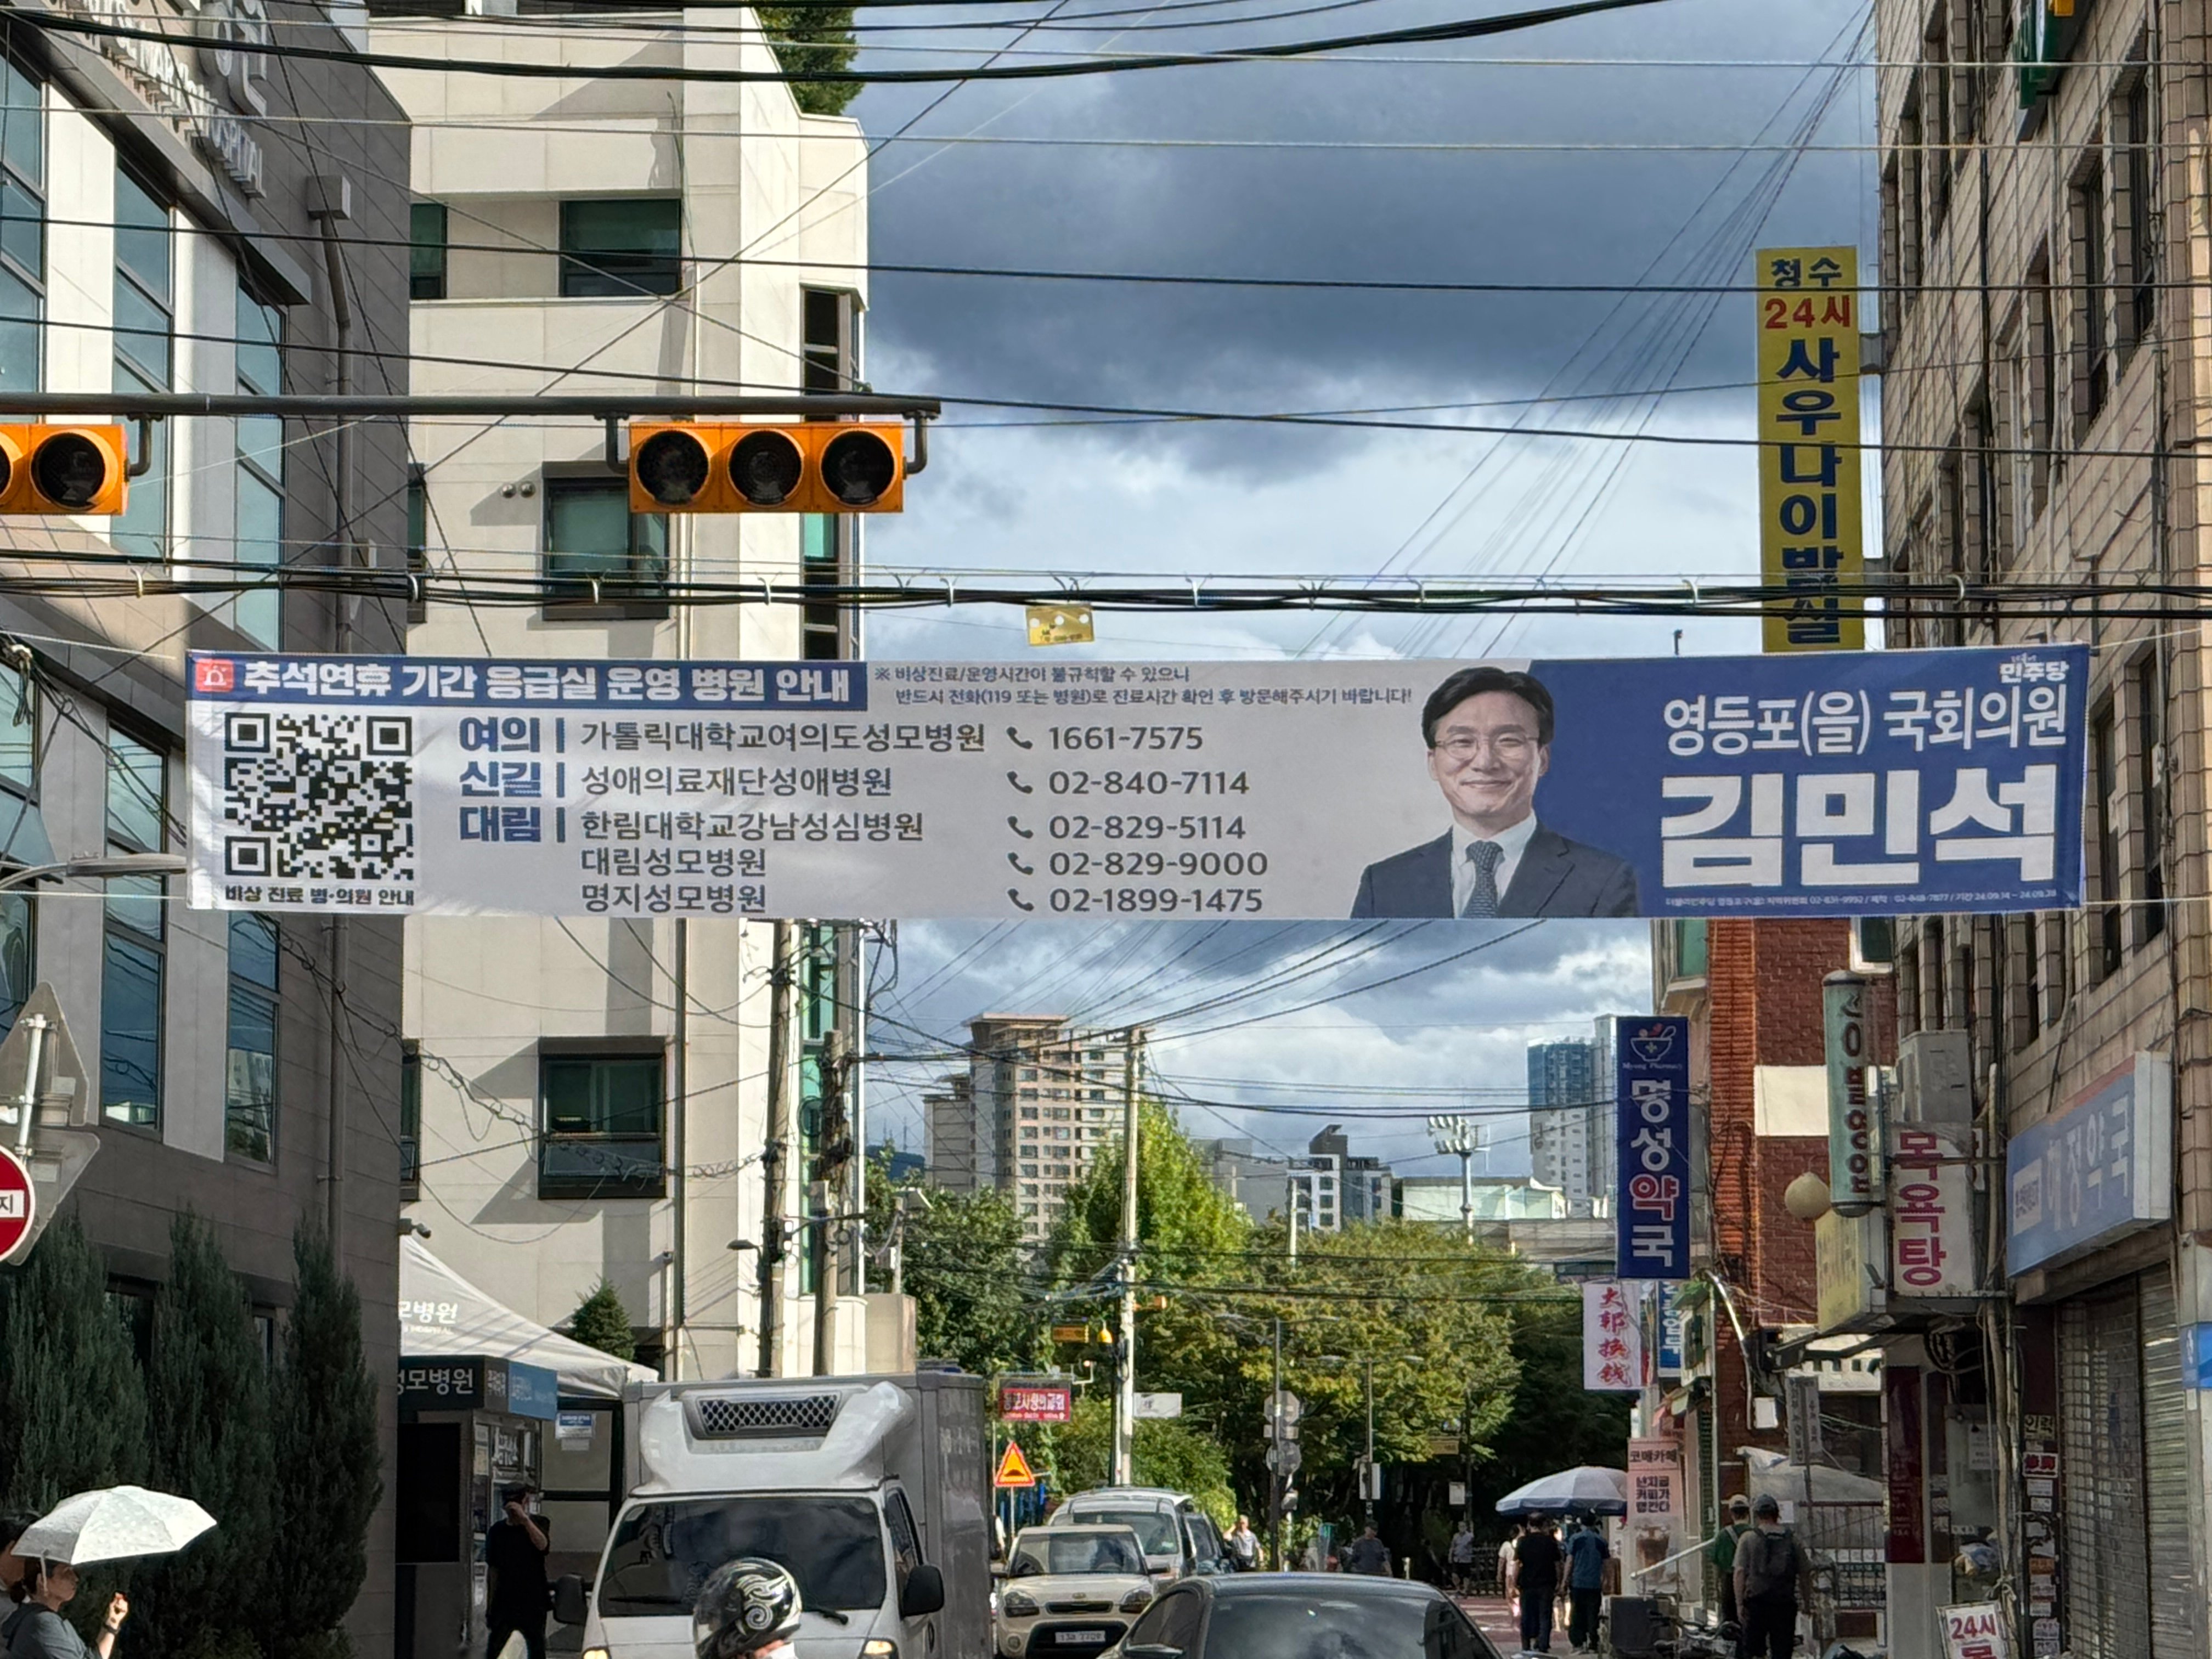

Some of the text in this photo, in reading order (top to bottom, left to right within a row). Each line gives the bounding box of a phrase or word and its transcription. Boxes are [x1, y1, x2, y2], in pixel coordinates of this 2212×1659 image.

[1771, 258, 1841, 287] 청수
[1765, 295, 1850, 329] 24시
[245, 661, 849, 702] 추석연휴 기간 응급실 운영 병원 안내
[895, 666, 1046, 682] 비상진료/운영시간이
[1120, 667, 1137, 682] 수
[1142, 666, 1189, 682] 있으니
[2000, 661, 2069, 683] 민주당
[896, 689, 943, 704] 반드시
[949, 689, 1012, 705] 전화(119
[1016, 689, 1049, 704] 또는
[1053, 689, 1108, 705] 병원)로
[1113, 689, 1178, 705] 진료시간
[1218, 689, 1235, 704] 후
[1239, 688, 1336, 704] 방문해주시기
[1342, 688, 1411, 704] 바랍니다!
[459, 716, 540, 753] 여의
[1663, 684, 2067, 757] 영등포(을) 국회의원
[581, 722, 1203, 752] 가톨릭대학교여의도성모병원 1661-7575
[459, 761, 541, 798] 신길
[581, 767, 1249, 797] 성애의료재단성애병원 02-840-7114
[459, 806, 541, 842] 대림
[581, 812, 1246, 842] 한림대학교강남성심병원 02-829-5114
[1661, 764, 2057, 888] 김민석
[581, 848, 1268, 877] 대림성모병원 02-829-9000
[225, 885, 262, 902] 비상
[268, 887, 303, 903] 진료
[378, 889, 414, 906] 안내
[581, 884, 1262, 913] 명지성모병원 02-1899-1475
[1629, 1079, 1679, 1267] 명성약국
[1897, 1132, 1945, 1286] 목욕탕
[1950, 1613, 1996, 1640] 24시
